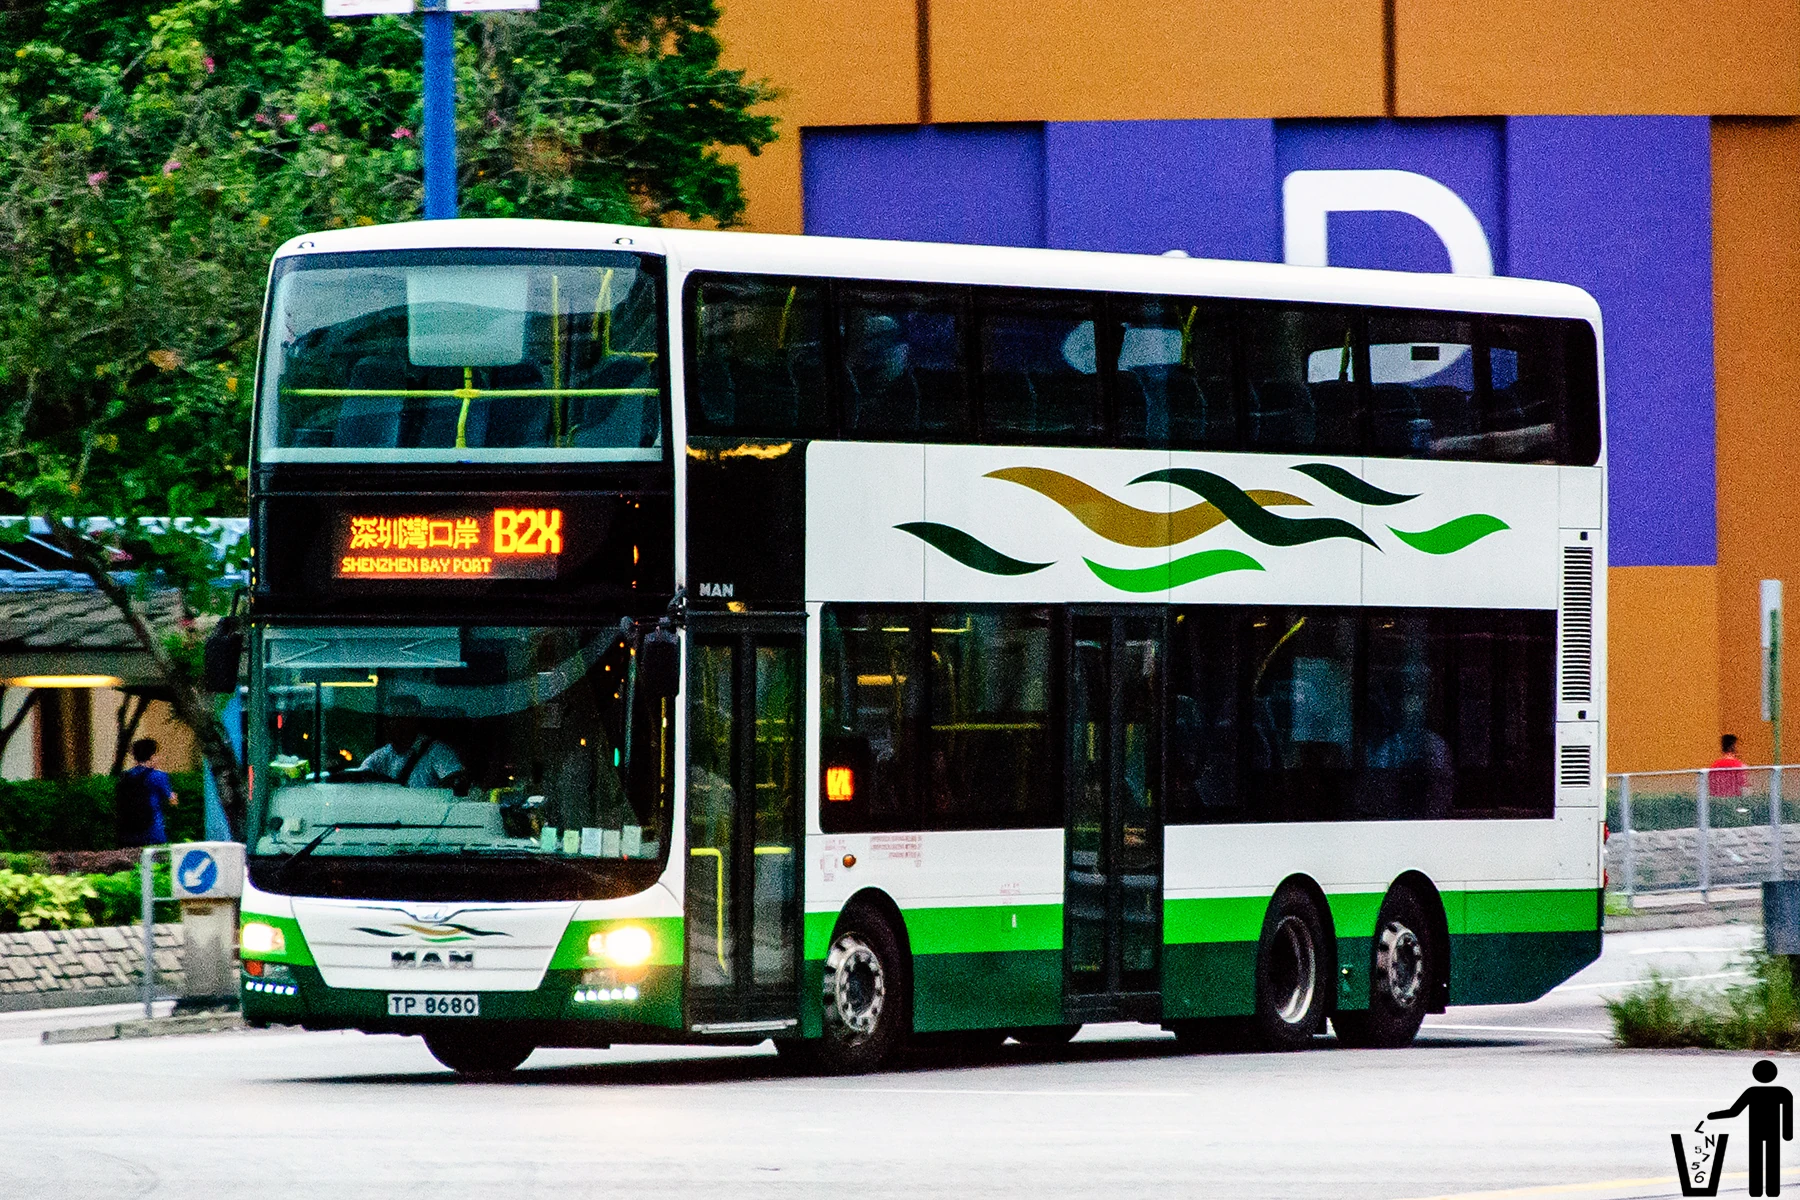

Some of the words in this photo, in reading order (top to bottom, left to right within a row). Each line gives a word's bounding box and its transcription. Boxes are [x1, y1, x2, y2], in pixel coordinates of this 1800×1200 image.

[350, 517, 478, 549] 深圳灣口岸
[494, 509, 562, 553] B2X
[341, 557, 418, 573] SHENZHEN
[420, 557, 450, 573] BAY
[453, 557, 492, 573] PORT
[699, 582, 734, 597] MAN
[391, 950, 473, 969] MAN
[392, 997, 416, 1013] TP
[425, 997, 476, 1013] 8680
